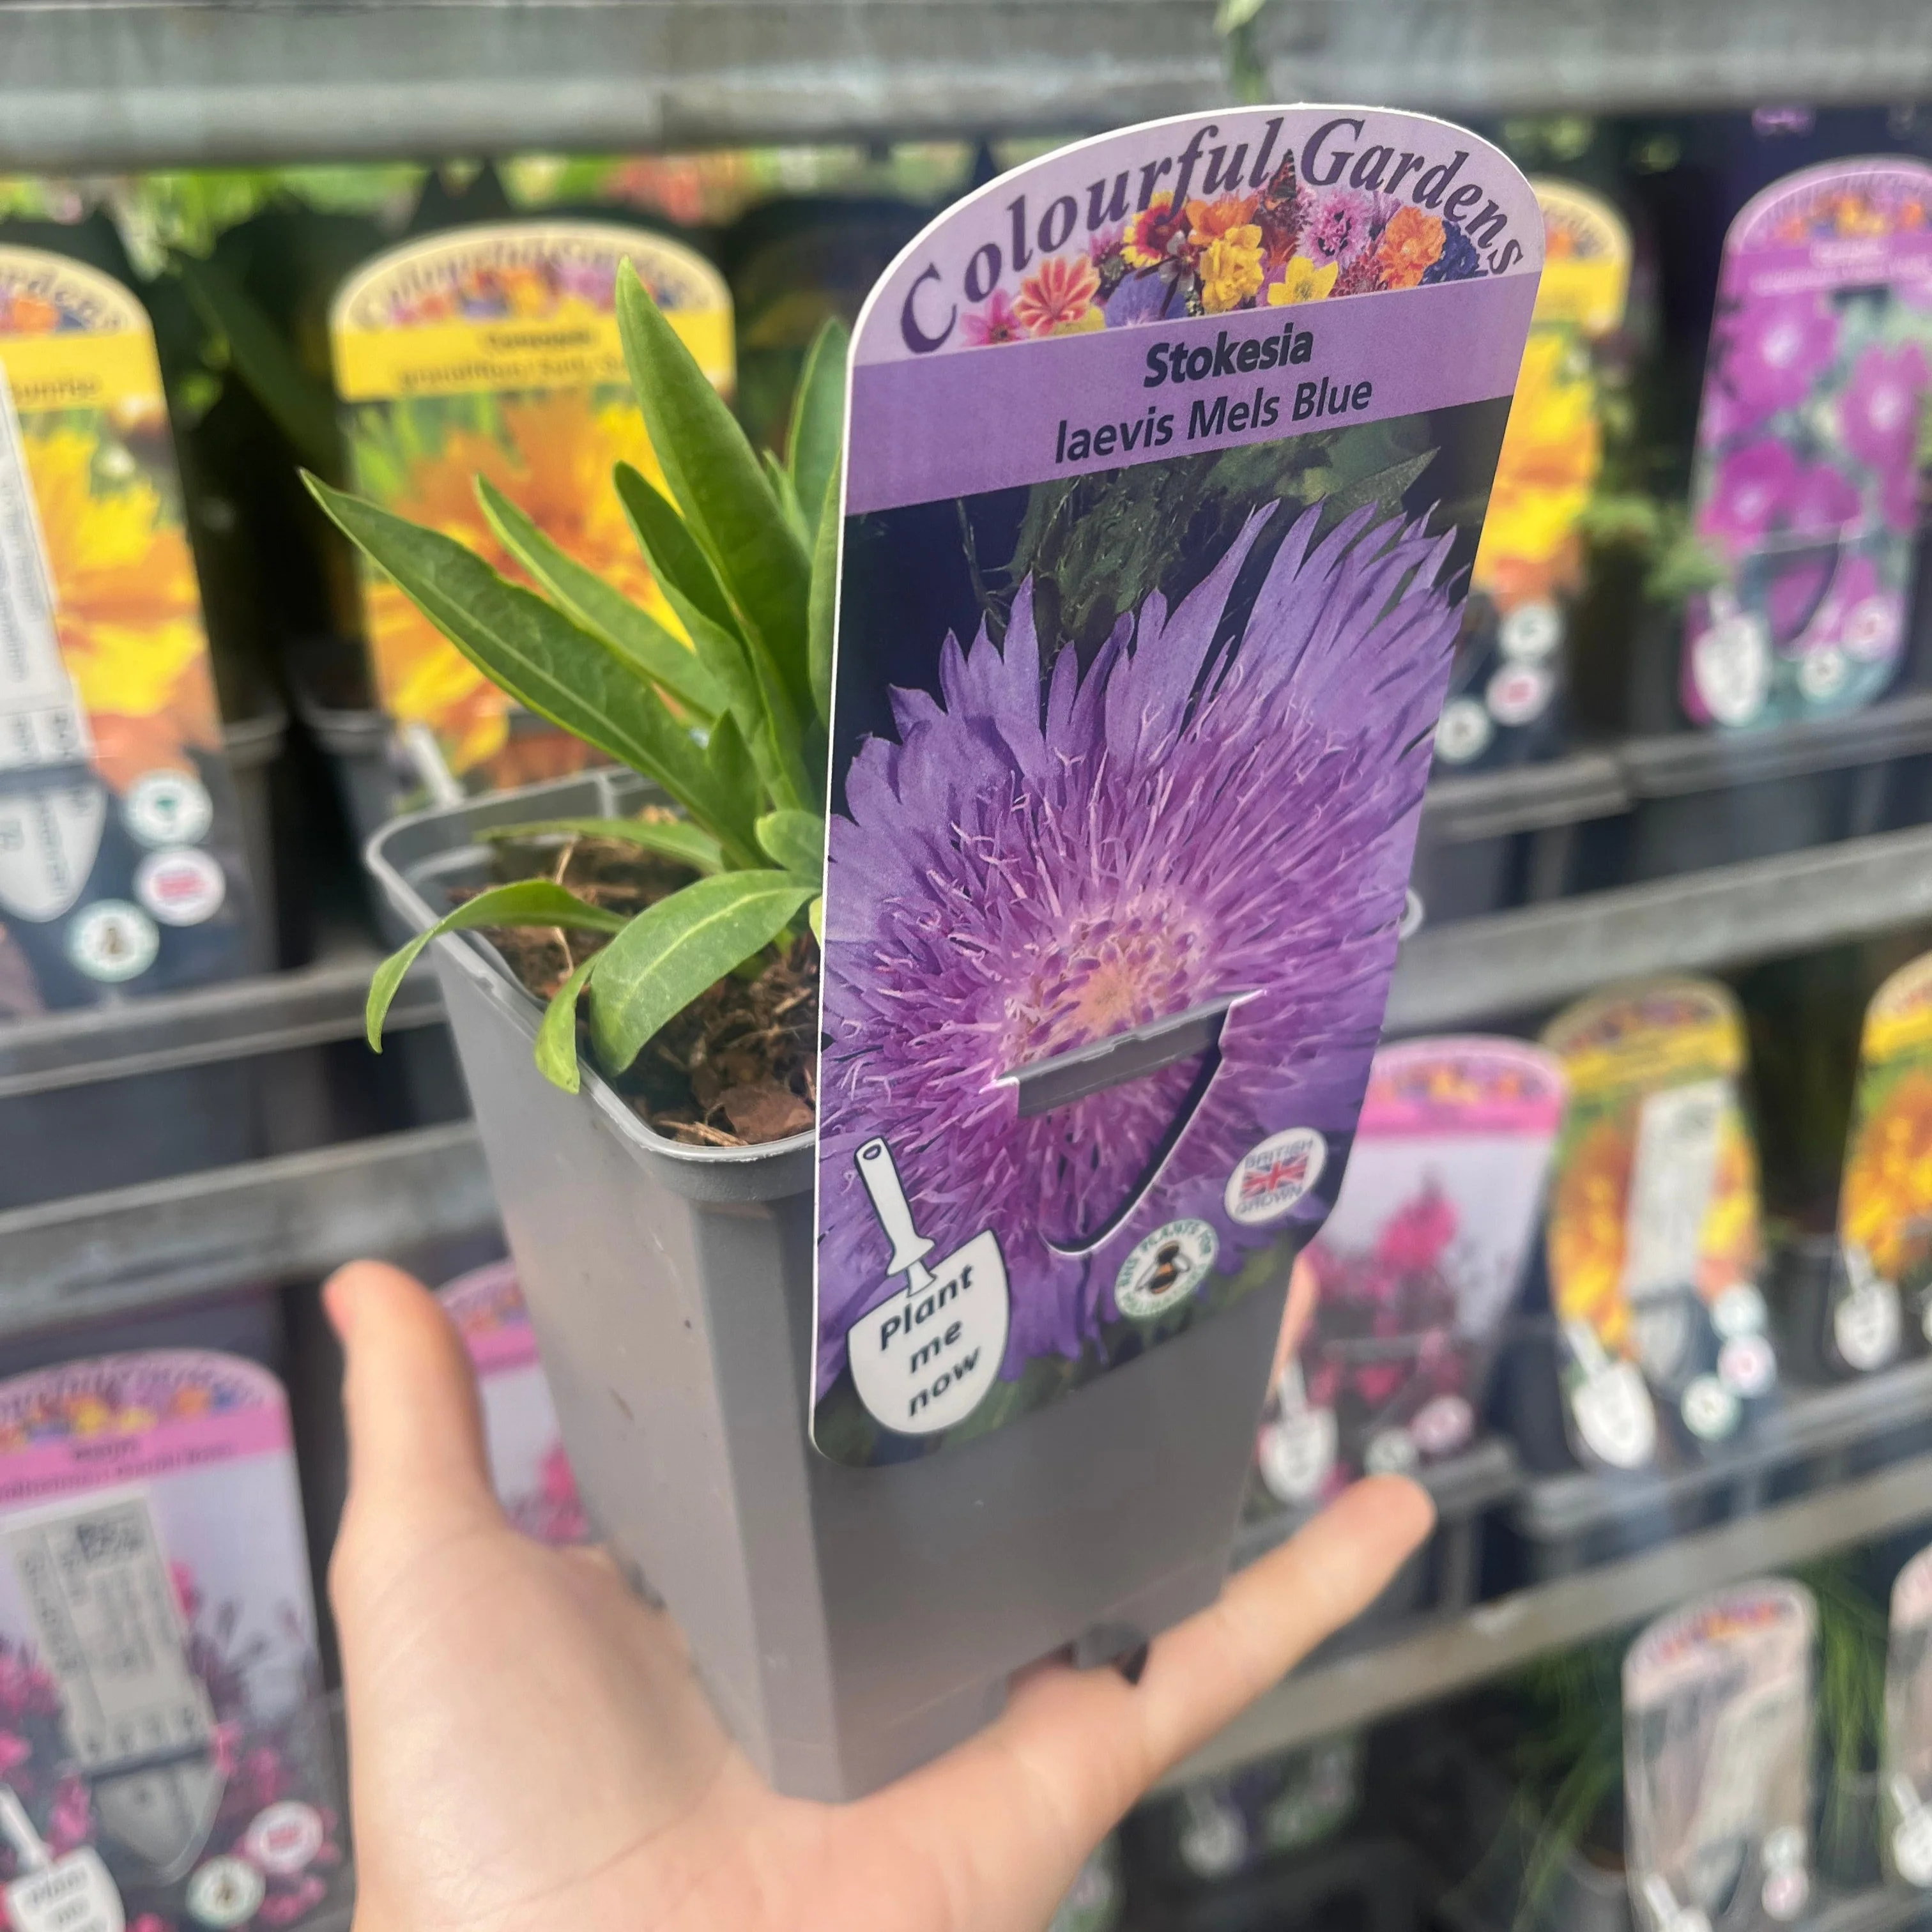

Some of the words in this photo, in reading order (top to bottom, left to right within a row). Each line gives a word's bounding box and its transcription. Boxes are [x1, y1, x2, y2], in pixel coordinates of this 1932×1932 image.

[901, 116, 1284, 353] Colourful
[1300, 118, 1524, 275] Gardens
[1144, 322, 1314, 388] Stokesia
[1055, 406, 1174, 464] laevis
[1187, 387, 1280, 440] Mels
[1291, 376, 1372, 422] Blue
[880, 1264, 974, 1351] Plant
[910, 1321, 963, 1373] me
[909, 1346, 981, 1417] now
